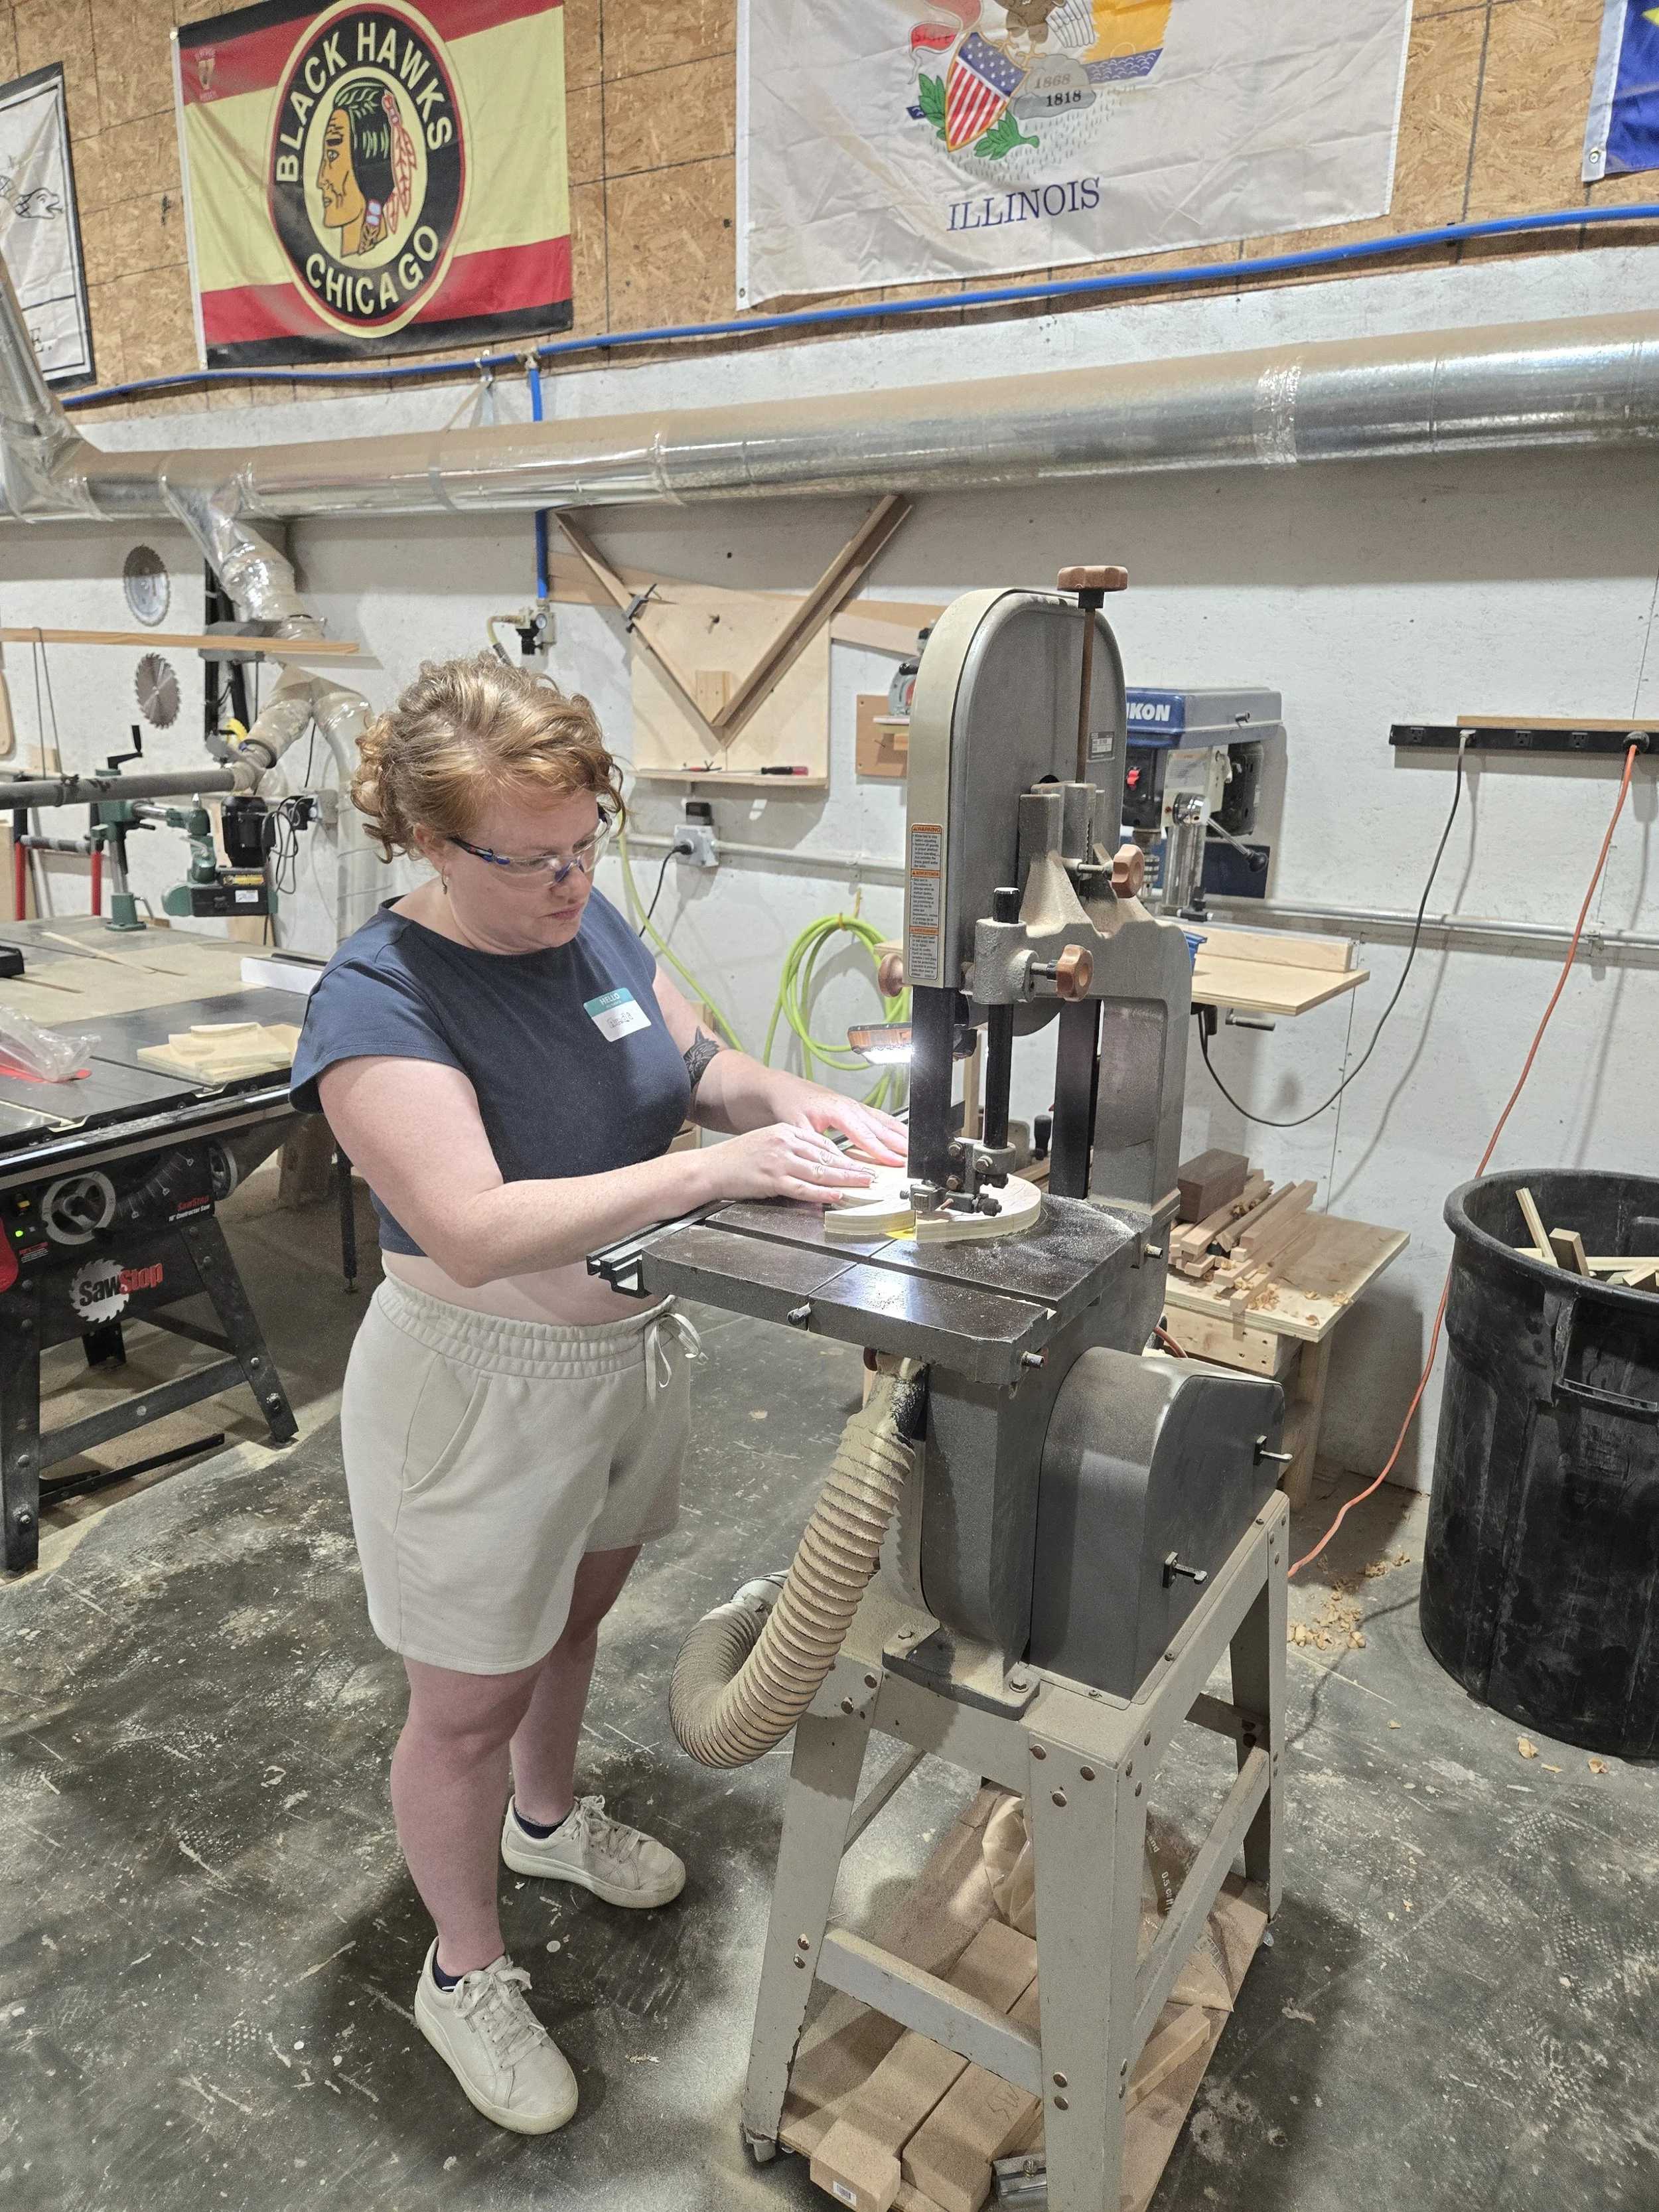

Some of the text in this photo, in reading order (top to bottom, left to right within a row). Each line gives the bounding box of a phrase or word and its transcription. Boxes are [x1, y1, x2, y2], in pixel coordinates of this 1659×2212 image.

[1034, 74, 1071, 89] 1868
[276, 23, 453, 182] BLACK HAWKS
[1046, 90, 1081, 107] 1818
[947, 177, 1100, 231] ILLINOIS
[306, 226, 439, 314] CHICAGO
[599, 992, 620, 1005] HELLO
[79, 1262, 163, 1306] SawStop
[1161, 1871, 1170, 1887] 0.5
